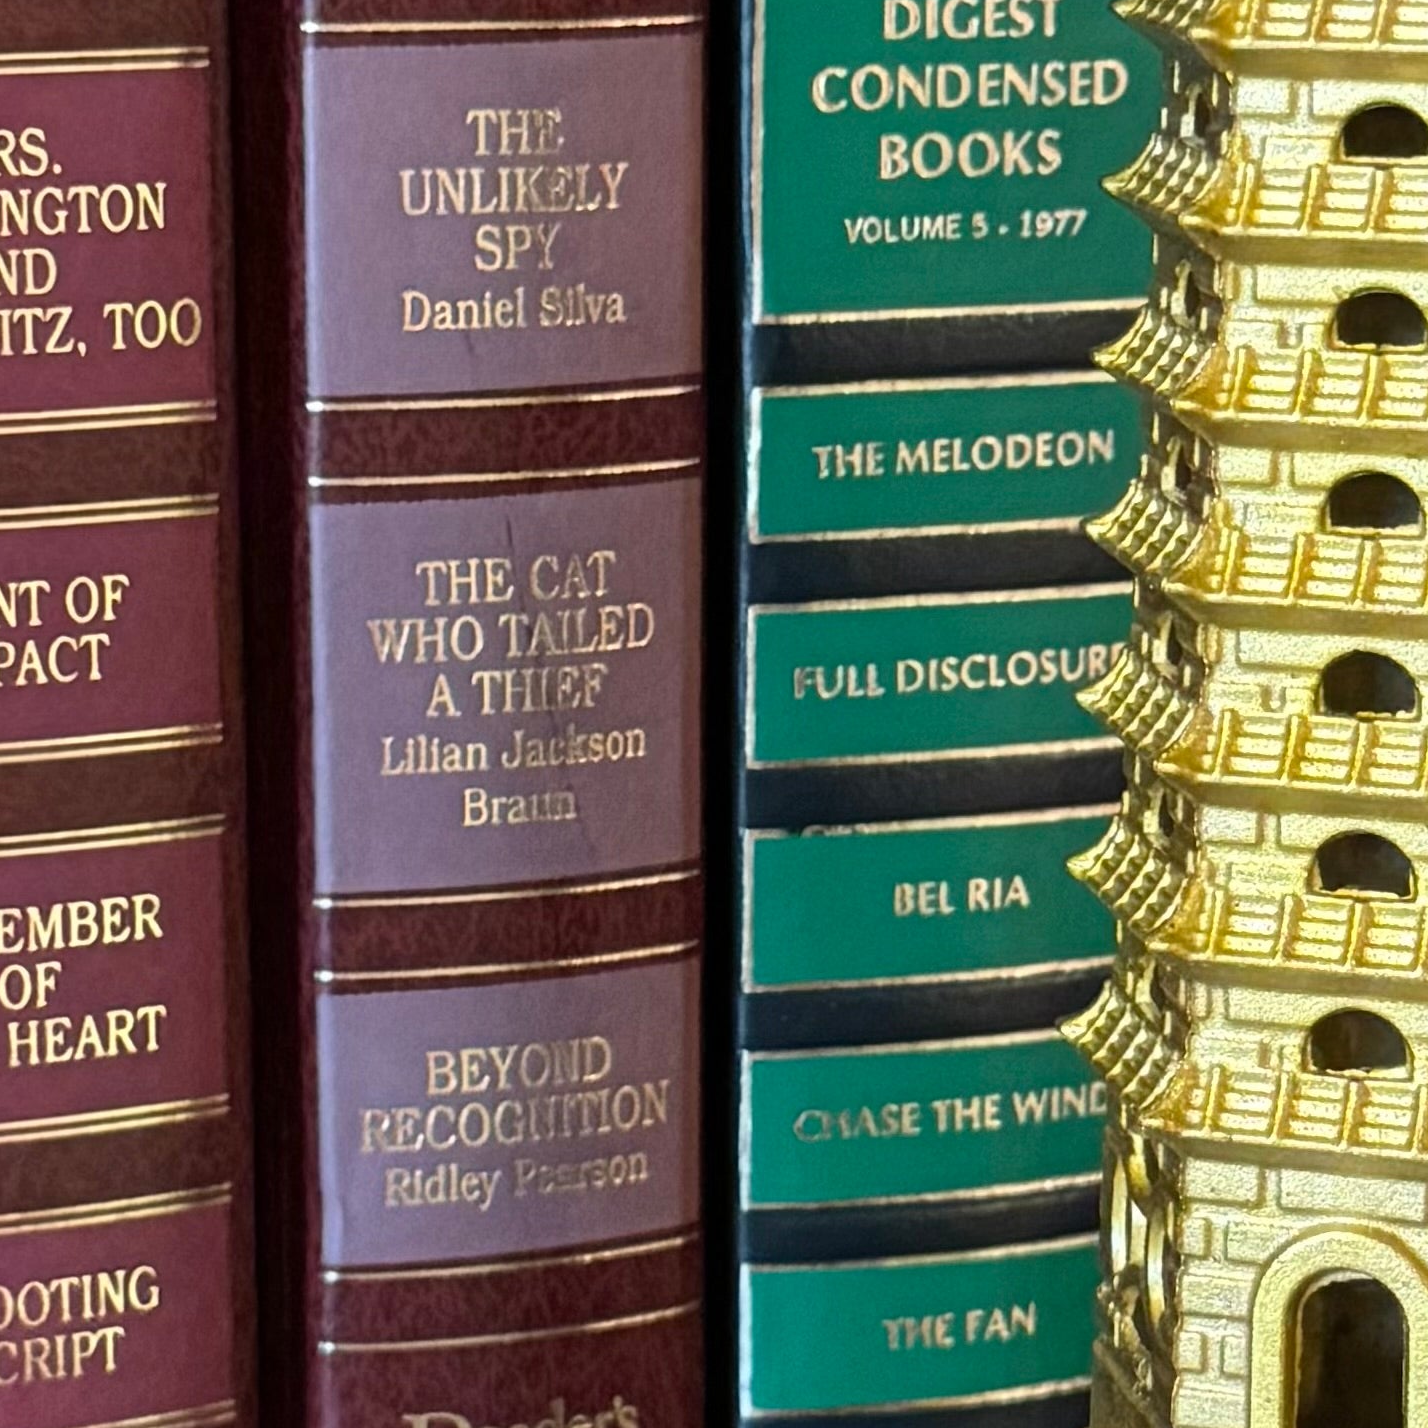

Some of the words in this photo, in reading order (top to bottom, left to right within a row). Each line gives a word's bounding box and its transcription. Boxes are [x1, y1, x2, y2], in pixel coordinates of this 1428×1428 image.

[811, 59, 1129, 115] CONDENSED
[466, 106, 565, 157] THE
[878, 129, 1063, 181] BOOKS
[398, 161, 629, 216] UNLIKELY
[473, 221, 562, 272] SPY
[844, 212, 962, 245] VOLUME
[972, 211, 988, 240] 5
[1020, 208, 1089, 240] 1977
[103, 297, 203, 350] TOO
[400, 286, 527, 333] Daniel
[539, 282, 627, 327] Silva
[812, 442, 885, 480] THE
[895, 428, 1115, 475] MELODEON
[65, 573, 131, 624] OF
[415, 557, 515, 607] THE
[529, 550, 617, 601] CAT
[367, 614, 484, 665] WHO
[498, 601, 655, 659] TAILED
[426, 673, 462, 719] A
[471, 662, 609, 715] THIEF
[793, 665, 885, 700] FULL
[380, 734, 488, 776] Lilian
[501, 722, 647, 769] Jackson
[462, 786, 577, 828] Braun
[893, 881, 955, 918] BEL
[967, 875, 1032, 912] RIA
[7, 1004, 168, 1068] HEART
[425, 1035, 613, 1097] BEYOND
[359, 1077, 672, 1154] RECOGNITION
[793, 1101, 922, 1143] CHASE
[931, 1093, 1003, 1135] THE
[384, 1168, 501, 1212] Ridley
[513, 1150, 649, 1199] Pearson
[882, 1315, 956, 1353] THE
[964, 1301, 1038, 1343] FAN
